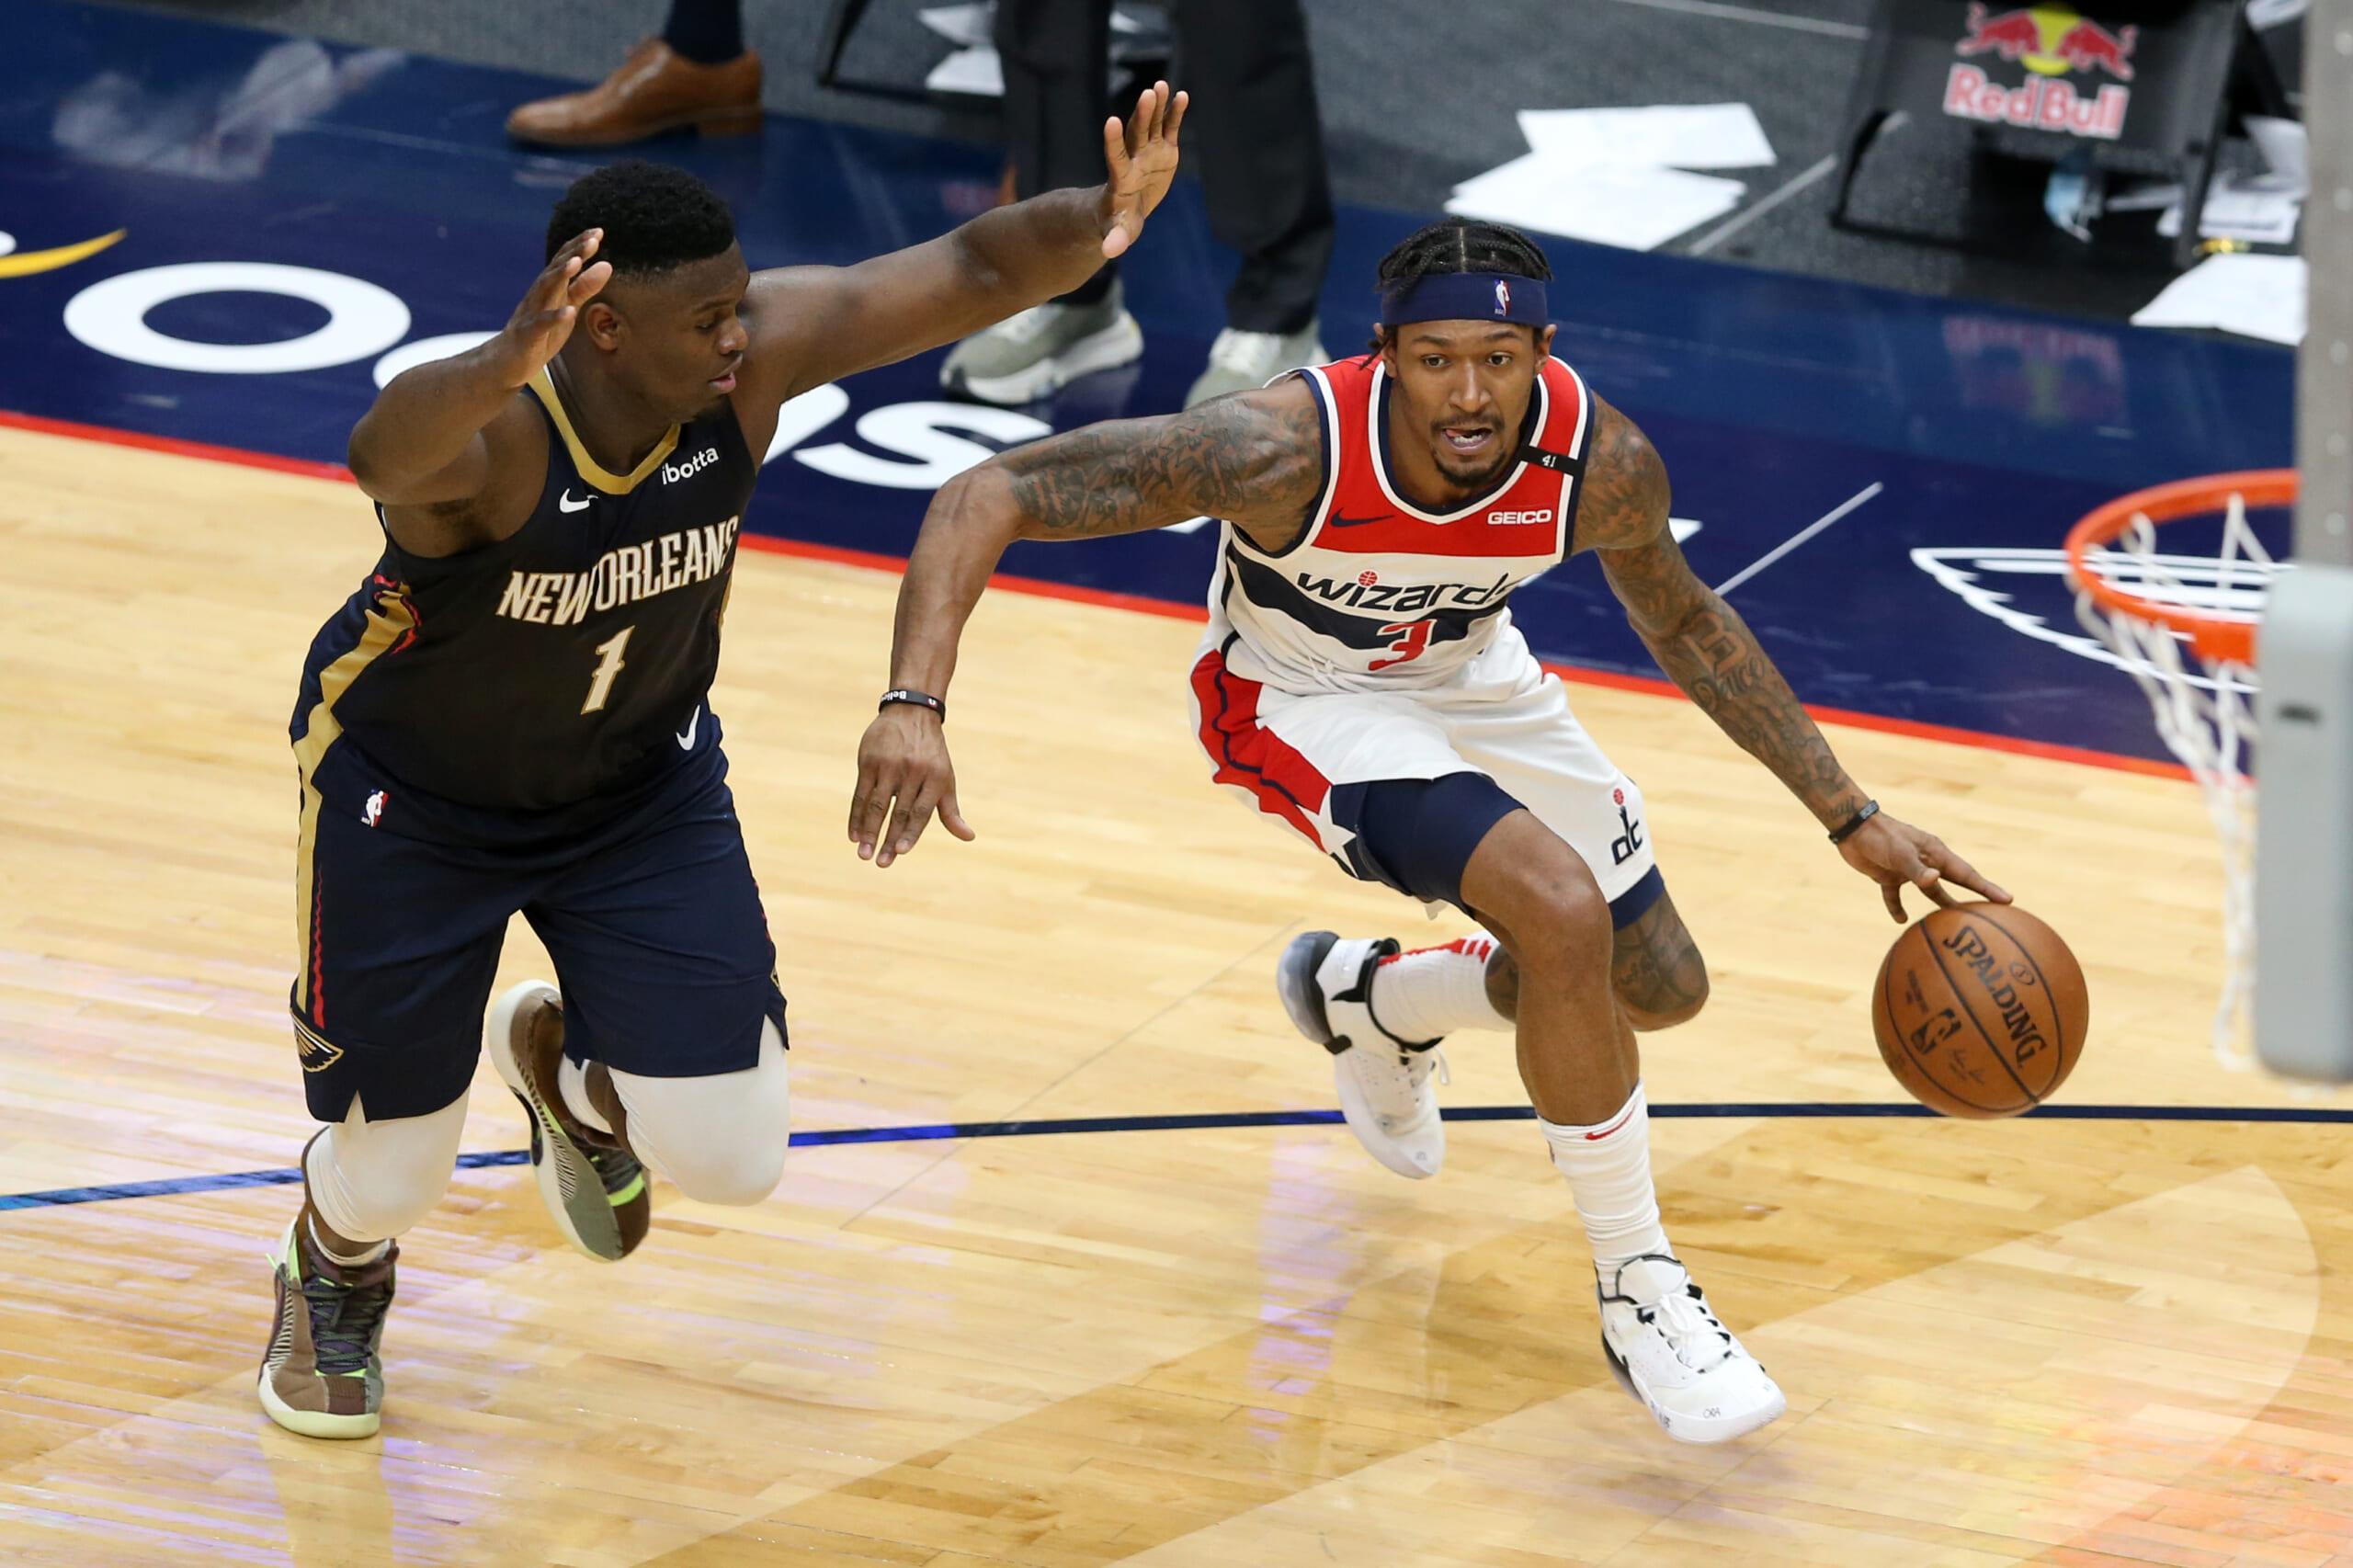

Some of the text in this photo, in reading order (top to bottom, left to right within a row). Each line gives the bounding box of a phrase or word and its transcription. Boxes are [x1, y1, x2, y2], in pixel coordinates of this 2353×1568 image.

[1943, 62, 2131, 140] Red Bull
[662, 448, 719, 485] ibotta
[1541, 454, 1556, 468] 41
[1487, 509, 1552, 525] GEICO
[495, 562, 600, 626] NEW
[580, 625, 635, 715] 1
[1368, 619, 1436, 671] 3
[1943, 926, 2047, 1066] SPALDING
